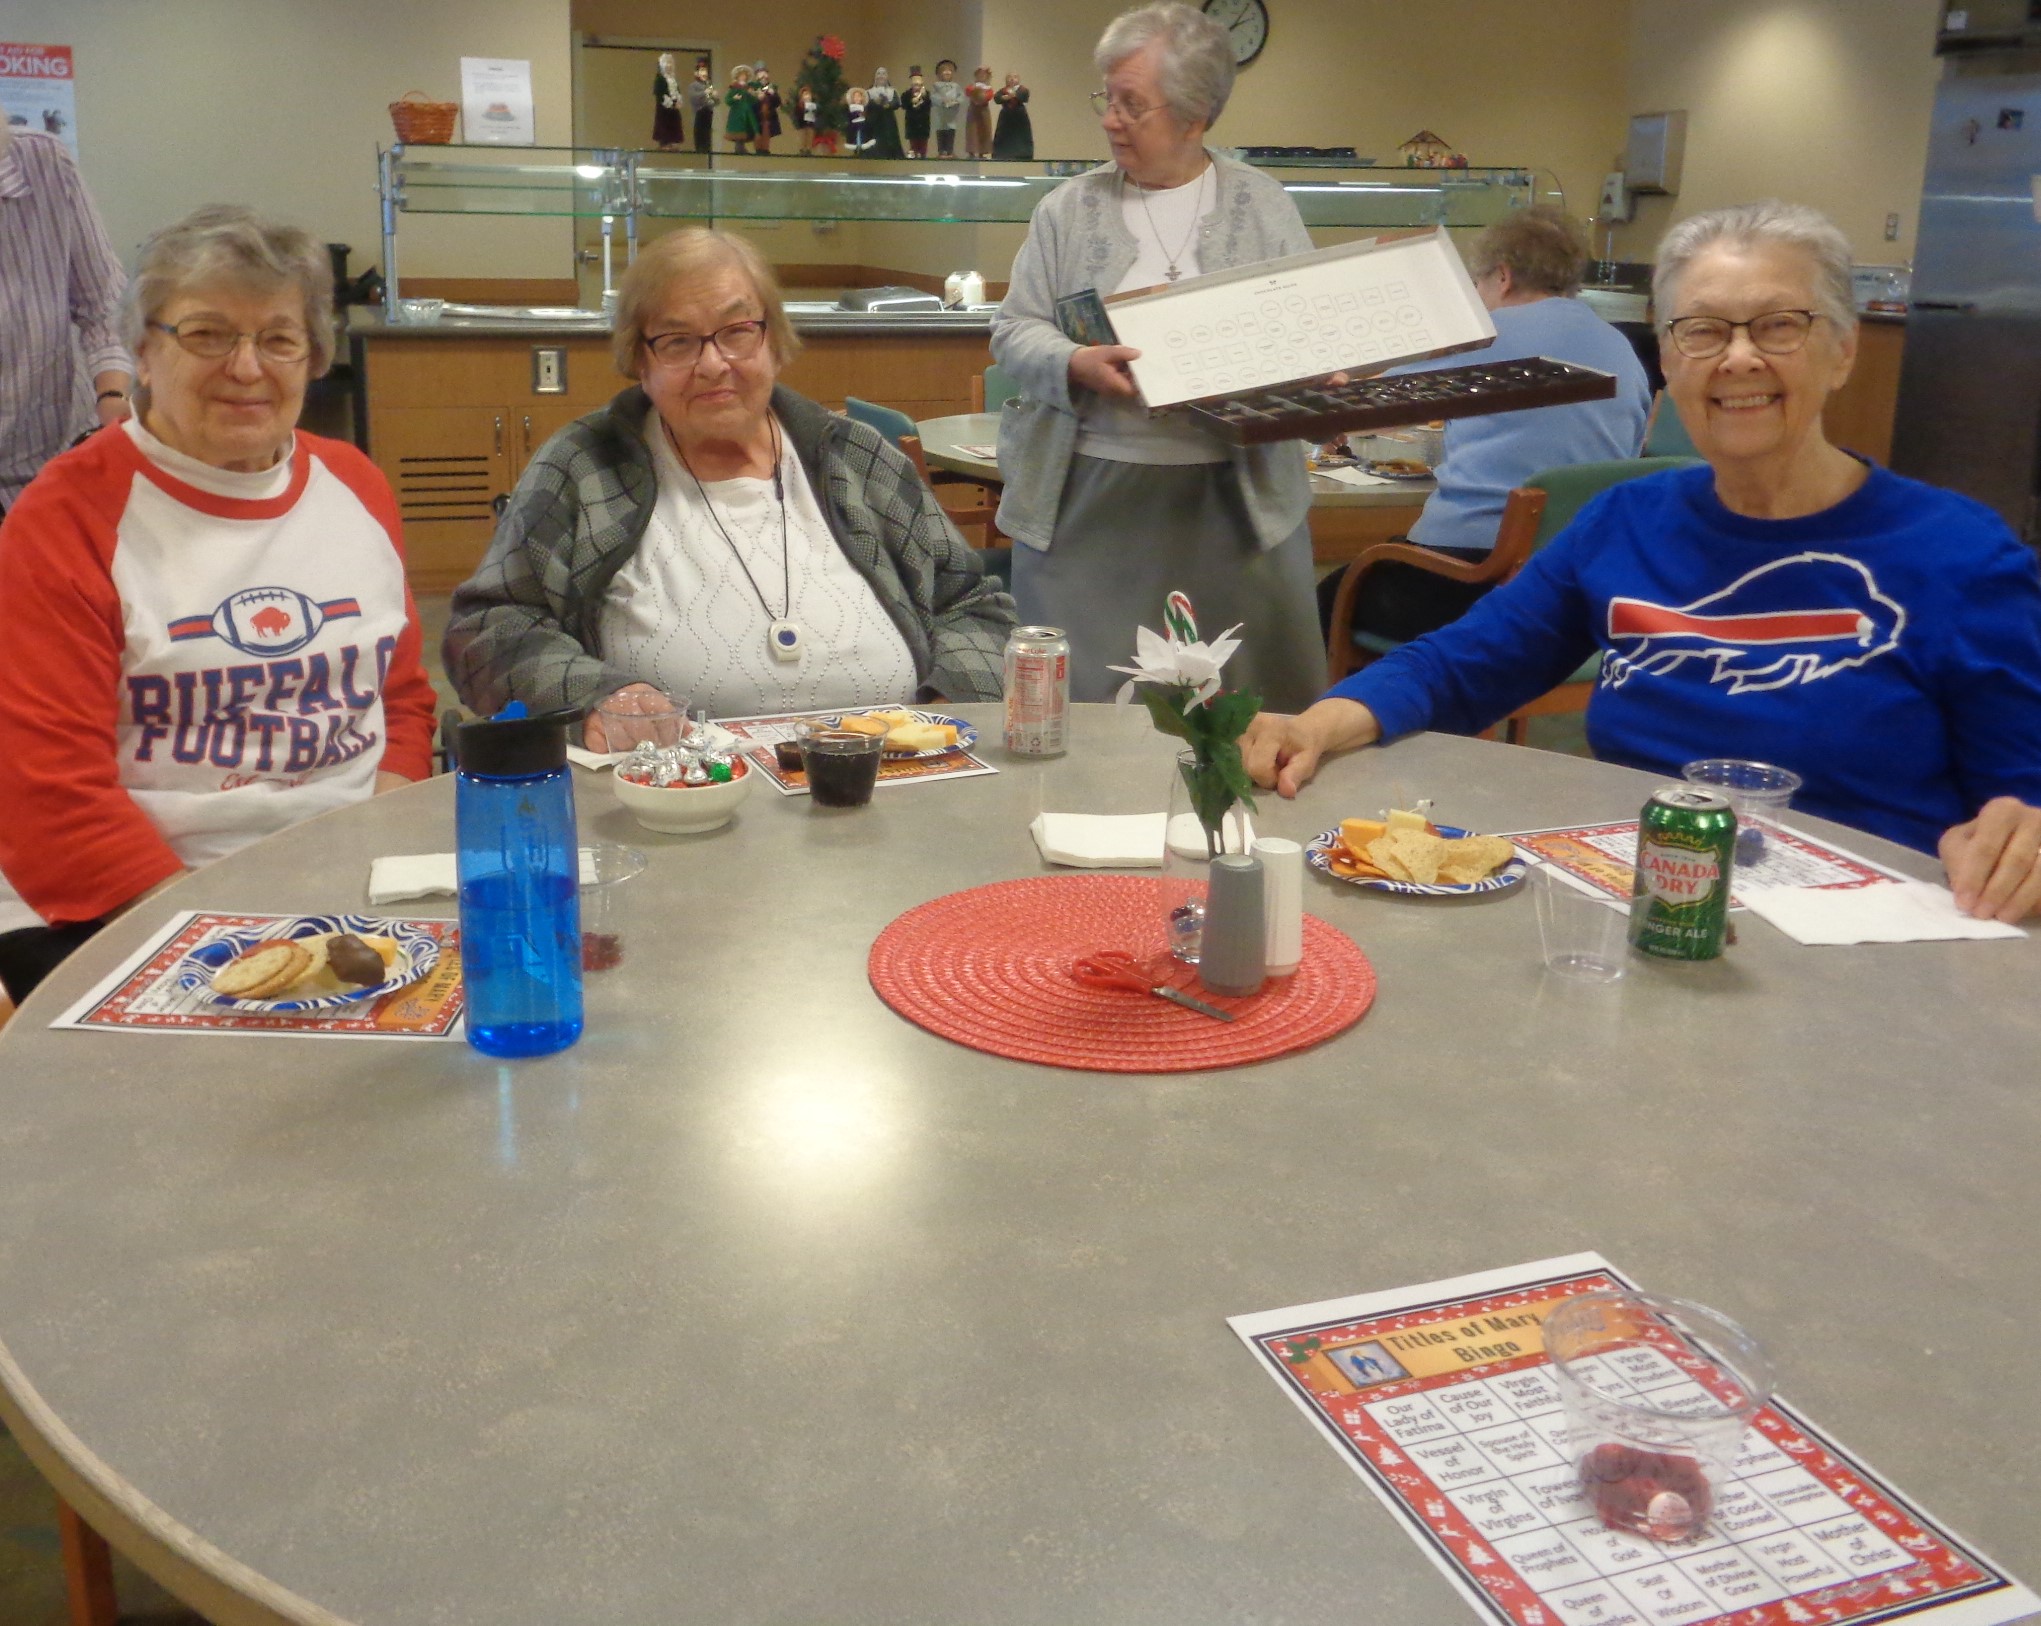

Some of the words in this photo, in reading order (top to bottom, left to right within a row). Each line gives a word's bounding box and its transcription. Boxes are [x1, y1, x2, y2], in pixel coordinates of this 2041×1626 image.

[135, 712, 376, 772] FOOTBALL
[1640, 851, 1720, 880] CANADA
[1655, 874, 1698, 895] DRY
[1647, 921, 1680, 937] NGER
[1685, 929, 1707, 939] ALE
[1386, 1327, 1457, 1351] Titles
[1461, 1322, 1485, 1337] of
[1488, 1312, 1541, 1331] Mary
[1452, 1339, 1522, 1362] Bingo
[1614, 1352, 1652, 1364] Virgin
[1627, 1361, 1661, 1372] Most
[1498, 1375, 1540, 1389] Virgin
[1439, 1388, 1483, 1402] Cause
[1511, 1385, 1547, 1397] Most
[1386, 1403, 1413, 1415] Our
[1450, 1404, 1465, 1414] of
[1466, 1399, 1493, 1410] Our
[1384, 1414, 1418, 1428] Lady
[1420, 1409, 1436, 1420] of
[1469, 1411, 1494, 1423] Joy
[1394, 1422, 1446, 1438] Fatima
[1478, 1435, 1517, 1449] Spouse
[1518, 1430, 1531, 1439] of
[1416, 1442, 1465, 1459] Vessel
[1506, 1449, 1537, 1462] Spirit
[1445, 1456, 1461, 1467] of
[1437, 1466, 1485, 1482] Honor
[1460, 1488, 1509, 1505] Virgin
[1539, 1497, 1554, 1509] of
[1489, 1502, 1507, 1514] of
[1727, 1500, 1764, 1516] Good
[1479, 1511, 1536, 1530] Virgins
[1723, 1510, 1777, 1530] Counsel
[1811, 1521, 1869, 1542] Mother
[1606, 1537, 1620, 1548] of
[1850, 1536, 1866, 1550] of
[1511, 1549, 1550, 1564] Queen
[1552, 1542, 1565, 1553] of
[1611, 1550, 1642, 1562] Gold
[1850, 1548, 1898, 1566] Christ
[1521, 1555, 1578, 1573] Prophets
[1695, 1559, 1740, 1574] Mother
[1636, 1574, 1668, 1588] Seat
[1705, 1576, 1718, 1587] of
[1718, 1569, 1758, 1584] Divine
[1723, 1582, 1761, 1596] Grace
[1562, 1593, 1608, 1609] Queen
[1655, 1600, 1707, 1617] Wisdom
[1588, 1605, 1603, 1617] of
